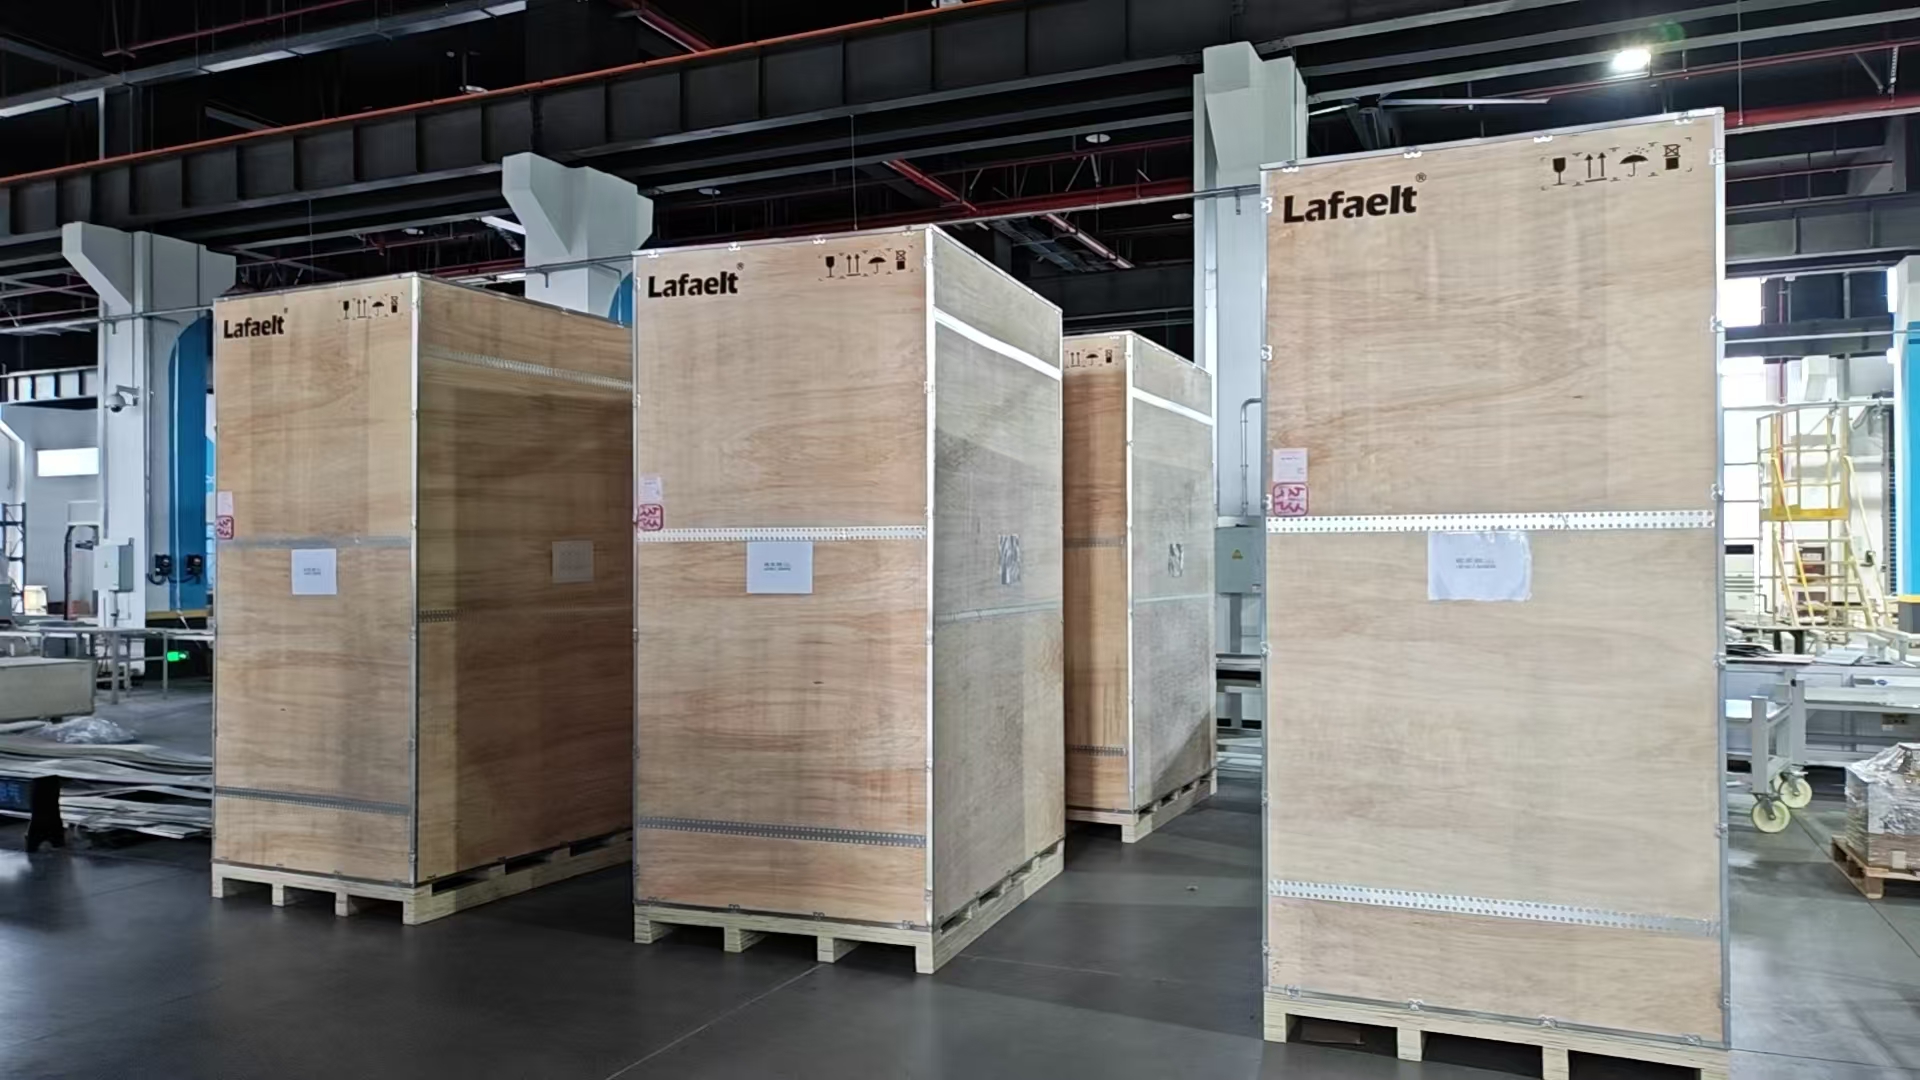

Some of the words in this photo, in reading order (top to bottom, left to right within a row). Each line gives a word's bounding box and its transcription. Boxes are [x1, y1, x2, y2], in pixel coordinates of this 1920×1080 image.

[1284, 185, 1417, 223] Lafaelt
[648, 271, 739, 298] Lafaelt
[224, 315, 285, 339] Lafaelt
